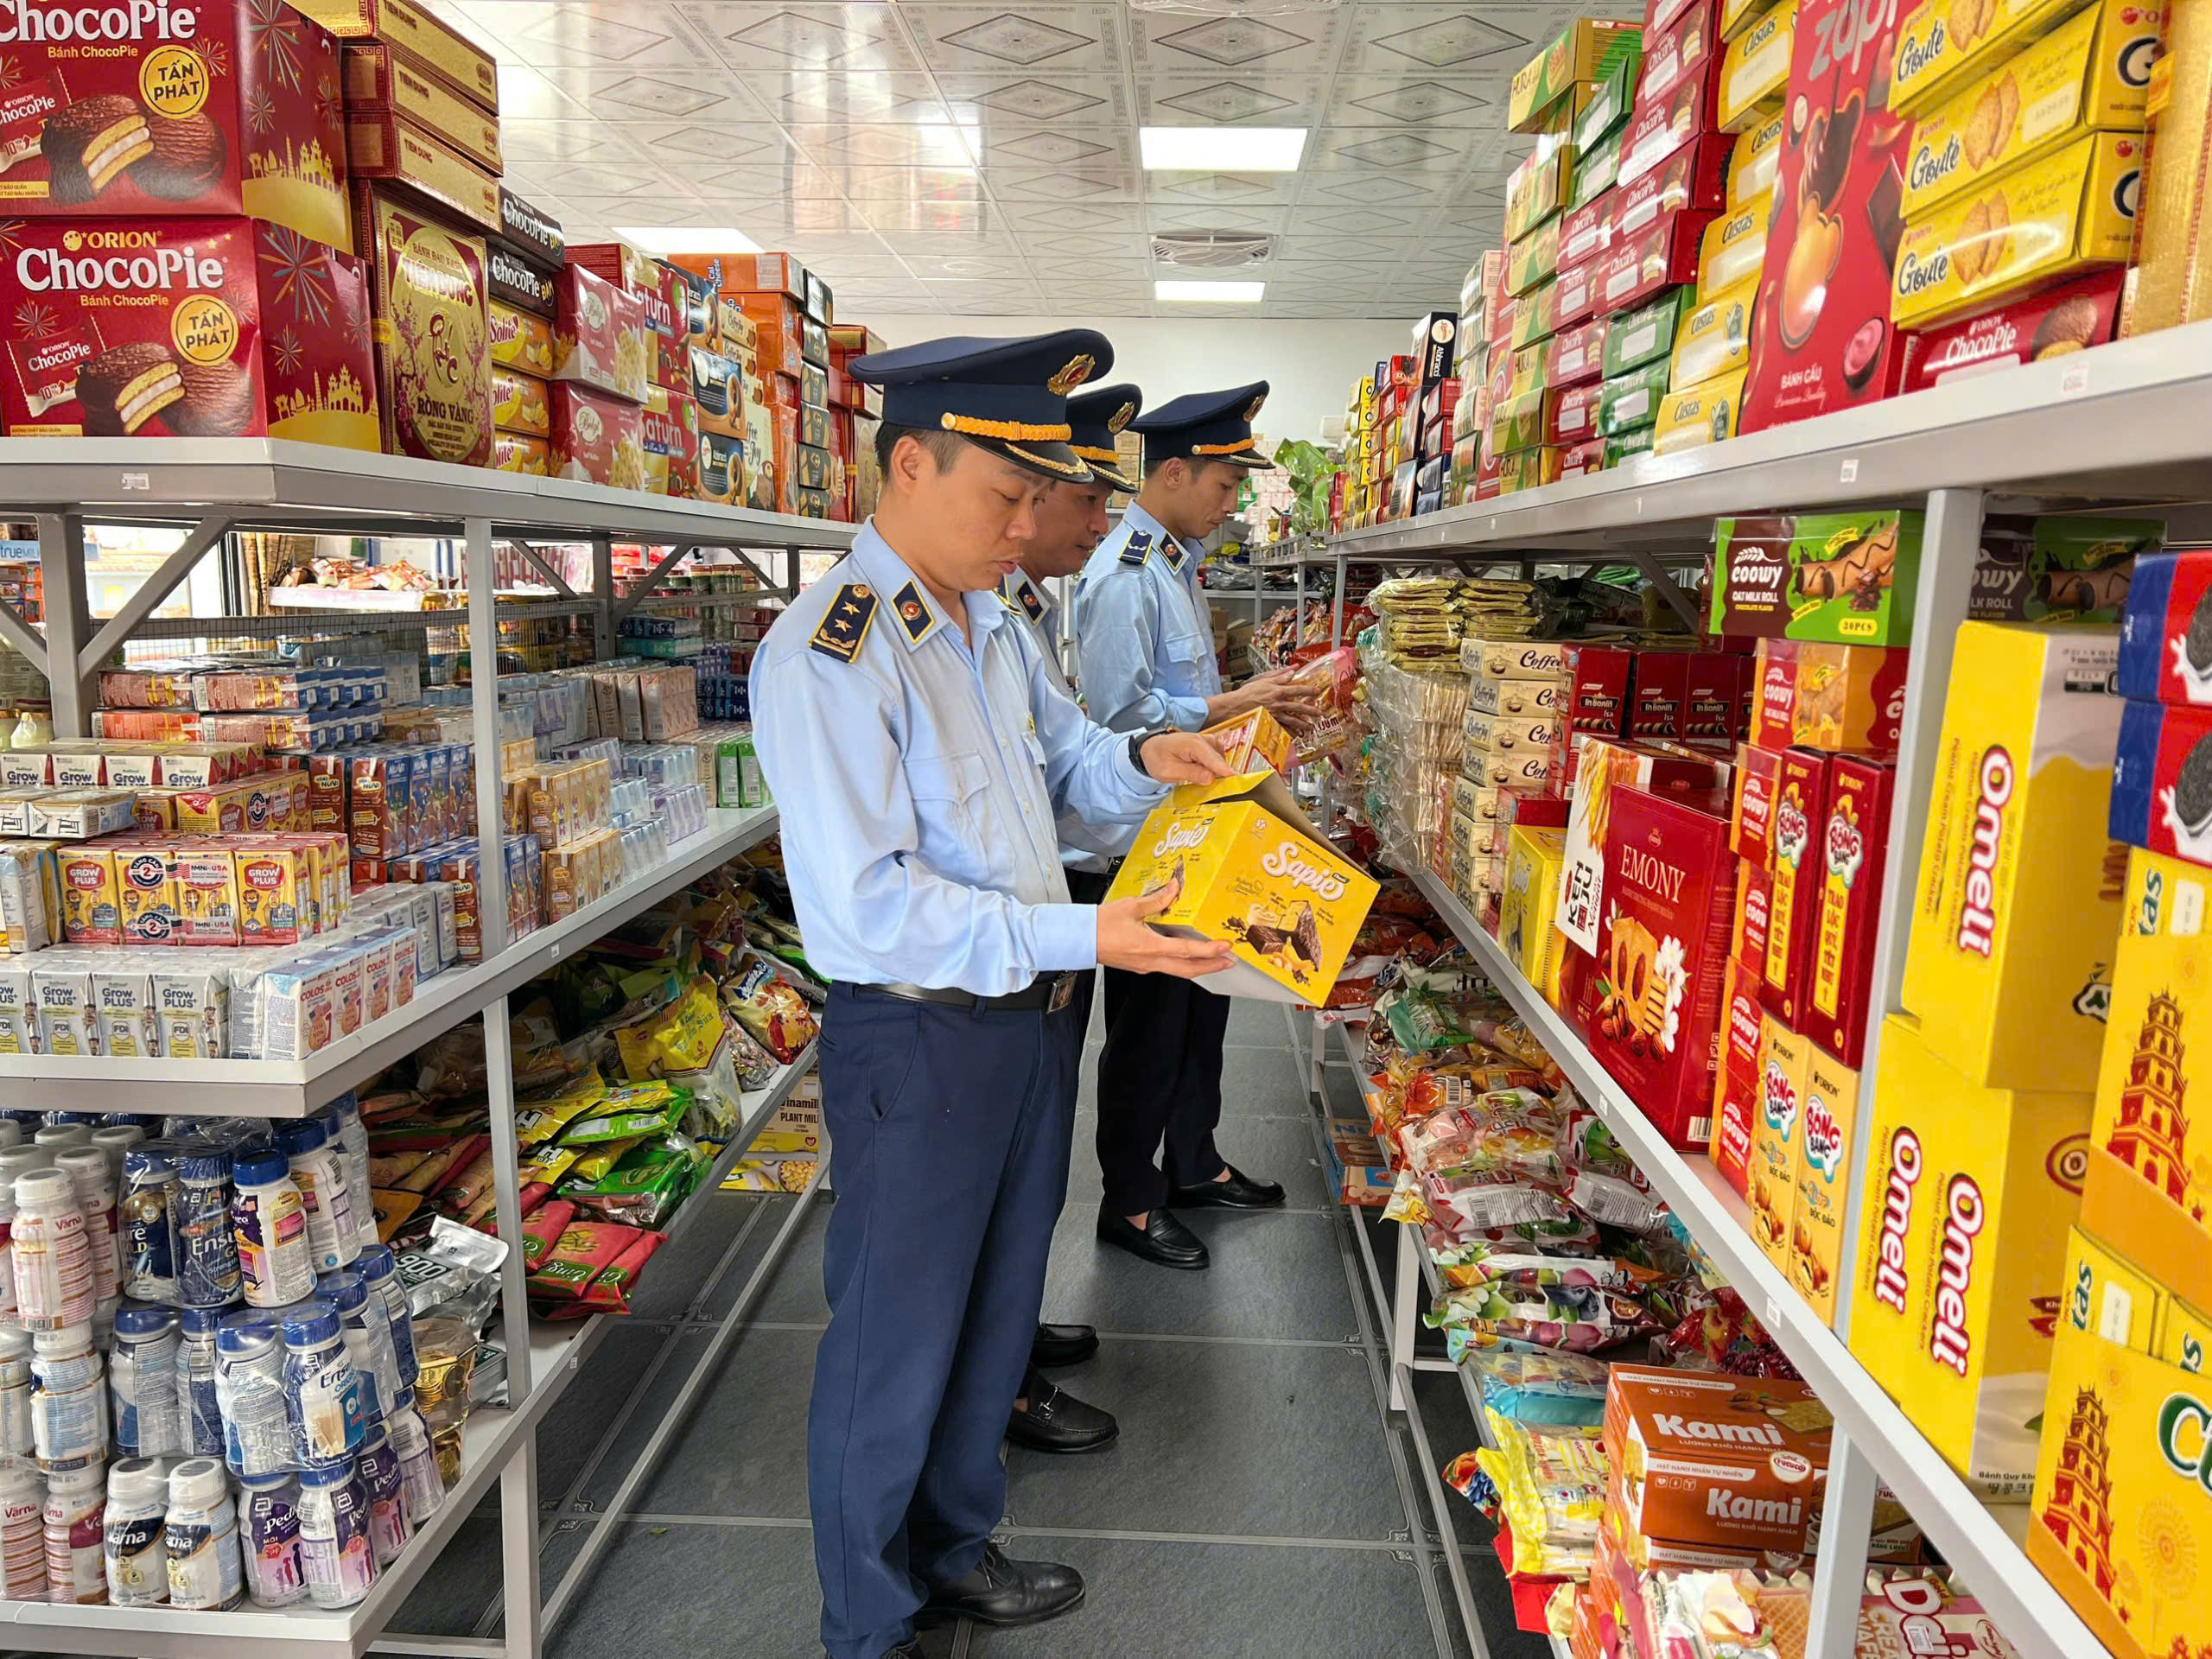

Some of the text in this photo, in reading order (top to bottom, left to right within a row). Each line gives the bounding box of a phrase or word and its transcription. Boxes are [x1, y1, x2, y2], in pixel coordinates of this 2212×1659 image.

[1744, 16, 1777, 58] Custas
[48, 45, 138, 59] Bánh ChocoPie
[158, 60, 194, 79] TẤN
[154, 78, 200, 101] PHÁT
[1636, 105, 1665, 141] ChocoPie
[1751, 118, 1783, 154] Custas
[504, 199, 549, 245] ChocoPie
[1722, 212, 1755, 245] Custas
[87, 231, 157, 249] ORION
[16, 246, 224, 291] ChocoPie
[493, 256, 540, 298] ChocoPie
[80, 294, 168, 307] Bánh ChocoPie
[189, 308, 224, 328] TẤN
[1691, 308, 1715, 336] Custas
[186, 327, 231, 348] PHÁT
[490, 317, 517, 344] Solite
[1946, 322, 2018, 366] ChocoPie
[28, 343, 91, 372] ChocoPie
[1782, 371, 1803, 390] BÁNH
[493, 378, 512, 407] olite
[448, 401, 474, 424] VÀNG
[1674, 398, 1700, 423] Custas
[641, 413, 683, 448] aturn
[496, 439, 512, 467] olite
[1732, 591, 1779, 603] OAT MILK ROLL
[1986, 598, 2013, 610] ROLL
[1604, 709, 1614, 718] Isa
[1664, 713, 1674, 721] Isa
[1715, 714, 1726, 722] Isa
[7, 770, 39, 785] Grow
[60, 771, 92, 785] Grow
[113, 772, 145, 786] Grow
[169, 773, 203, 787] Grow
[1154, 822, 1209, 858] Sapie
[1958, 743, 2015, 959] Omeli
[70, 867, 99, 878] GROW
[75, 875, 98, 886] PLUS
[143, 866, 151, 877] 2
[248, 867, 279, 879] GROW
[253, 876, 276, 886] PLUS
[1262, 842, 1345, 902] Sapie
[1620, 844, 1686, 904] EMONY
[149, 921, 157, 931] 2
[366, 961, 386, 975] COLOS
[335, 972, 357, 987] COLOS
[43, 987, 73, 996] Grow
[102, 988, 132, 997] Grow
[162, 989, 193, 999] Grow
[301, 985, 325, 1001] COLOS
[781, 1113, 800, 1123] PLANT
[1874, 1125, 1923, 1316] Omeli
[397, 1255, 447, 1279] 900
[1929, 1171, 1986, 1379] Omeli
[1652, 1413, 1785, 1446] Kami
[1979, 1470, 2020, 1482] Bánh Quy
[1707, 1488, 1802, 1525] Kami
